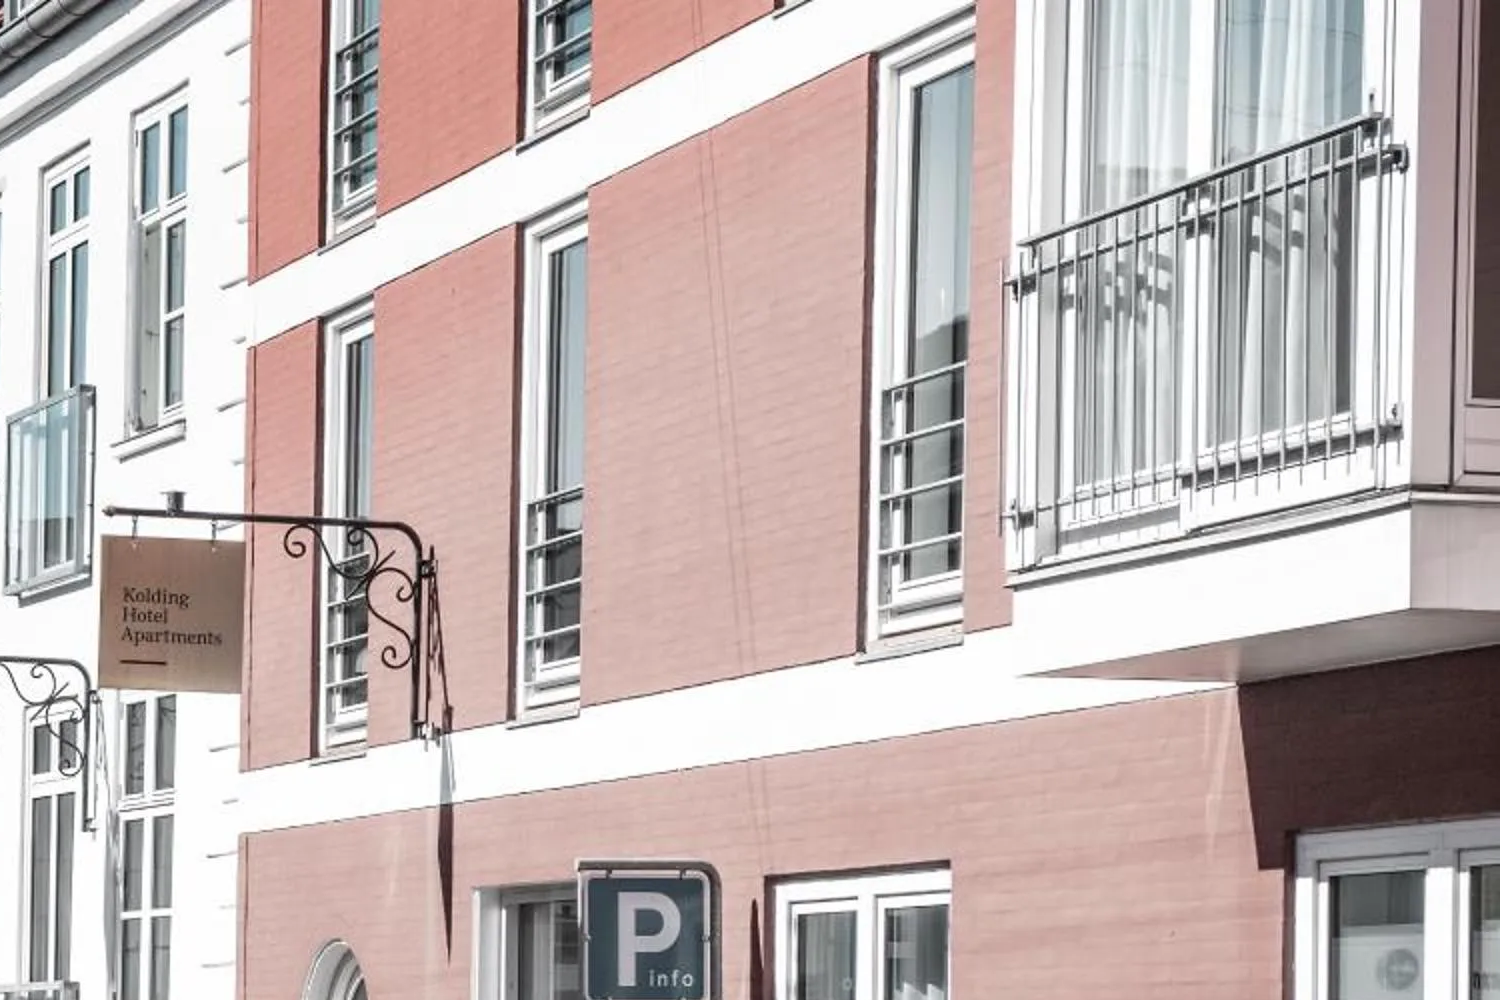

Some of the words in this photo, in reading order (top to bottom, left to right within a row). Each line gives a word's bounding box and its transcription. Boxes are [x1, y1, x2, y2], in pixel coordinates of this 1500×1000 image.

[122, 586, 190, 608] Kolding
[122, 607, 168, 623] Hotel
[121, 626, 223, 646] Apartments
[617, 891, 682, 987] P
[650, 969, 695, 988] info
